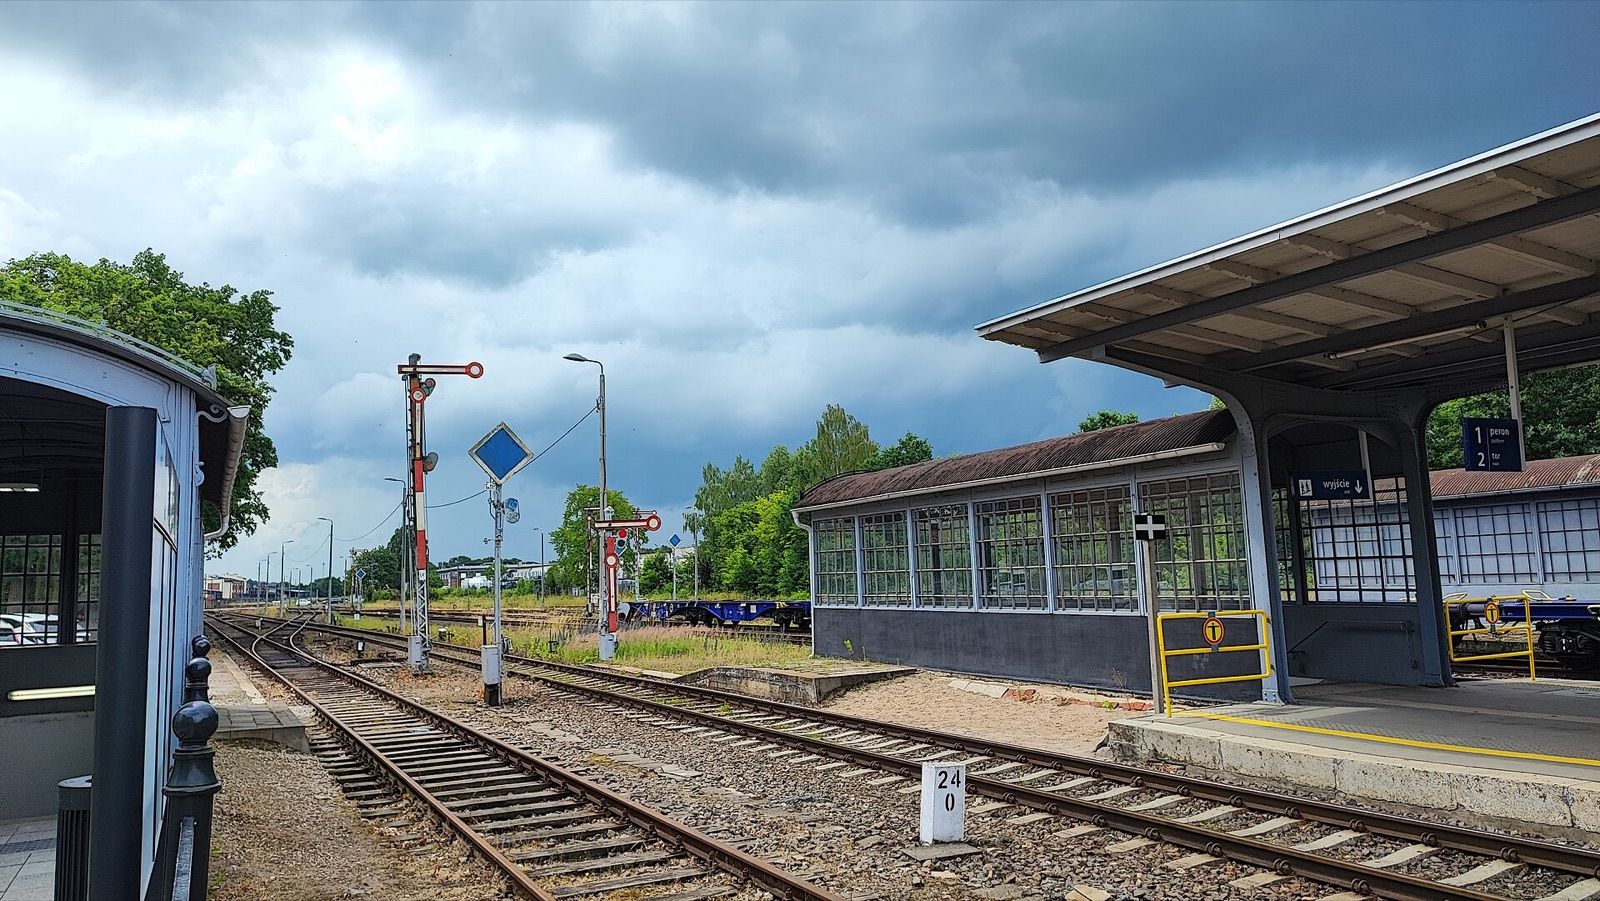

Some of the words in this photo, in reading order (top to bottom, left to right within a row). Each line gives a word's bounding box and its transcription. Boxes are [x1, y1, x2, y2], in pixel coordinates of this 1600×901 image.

[1474, 426, 1481, 444] 1
[1489, 428, 1510, 437] peron
[1477, 452, 1486, 467] 2
[1322, 478, 1350, 490] wyjście
[938, 769, 961, 789] 24
[945, 792, 955, 812] 0
